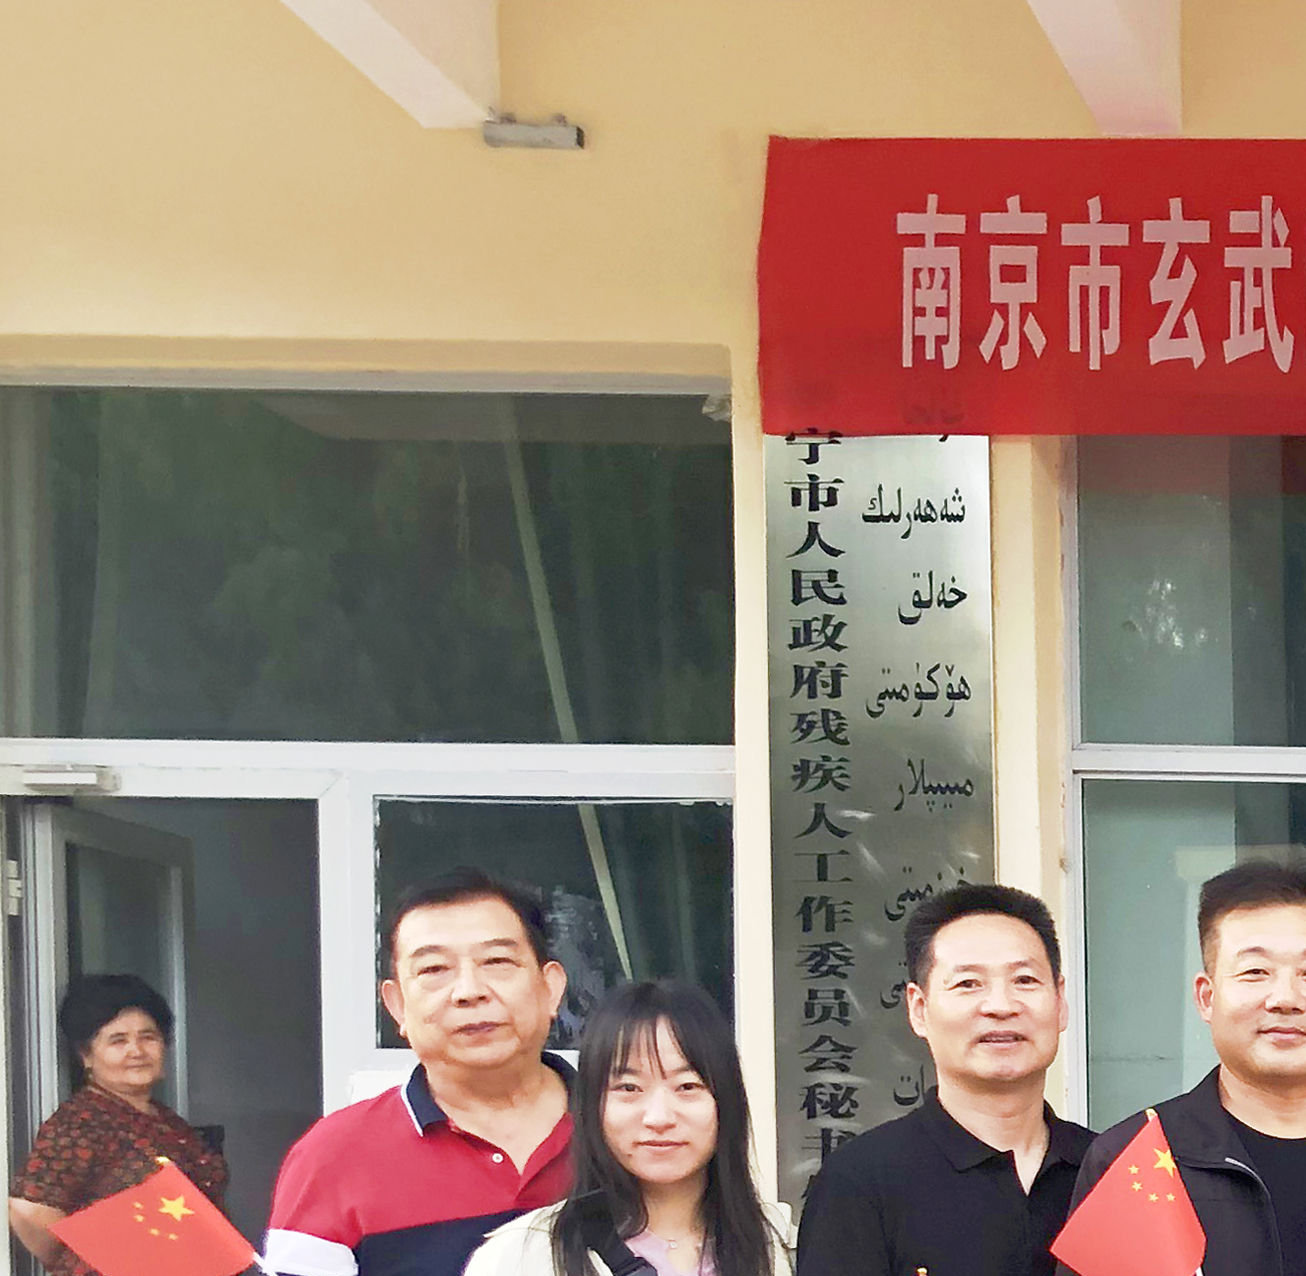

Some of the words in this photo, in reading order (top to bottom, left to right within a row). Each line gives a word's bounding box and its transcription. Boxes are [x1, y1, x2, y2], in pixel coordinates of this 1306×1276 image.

[784, 428, 859, 1200] 宁市人民政府残疾人工作委员会秘书
